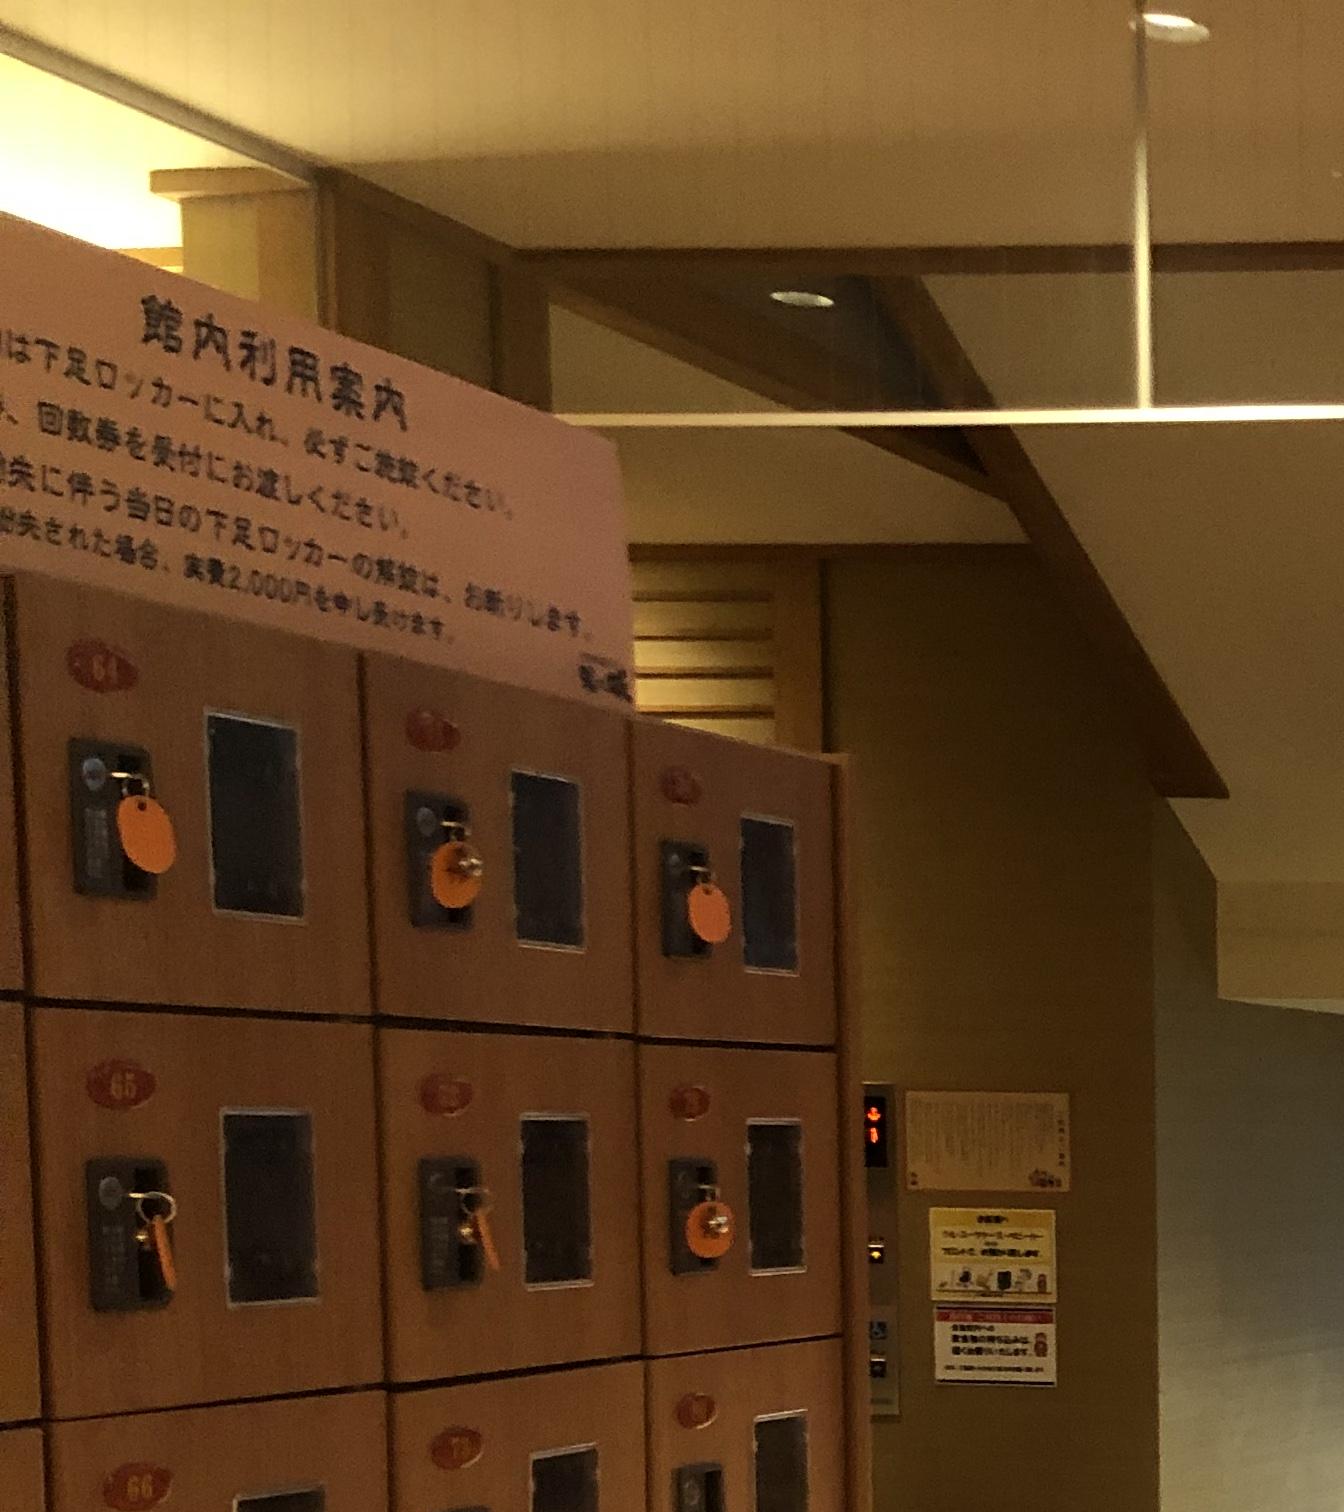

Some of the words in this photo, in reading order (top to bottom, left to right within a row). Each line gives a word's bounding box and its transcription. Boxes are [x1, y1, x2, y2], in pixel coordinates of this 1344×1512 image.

[139, 294, 409, 432] 館内利用案内
